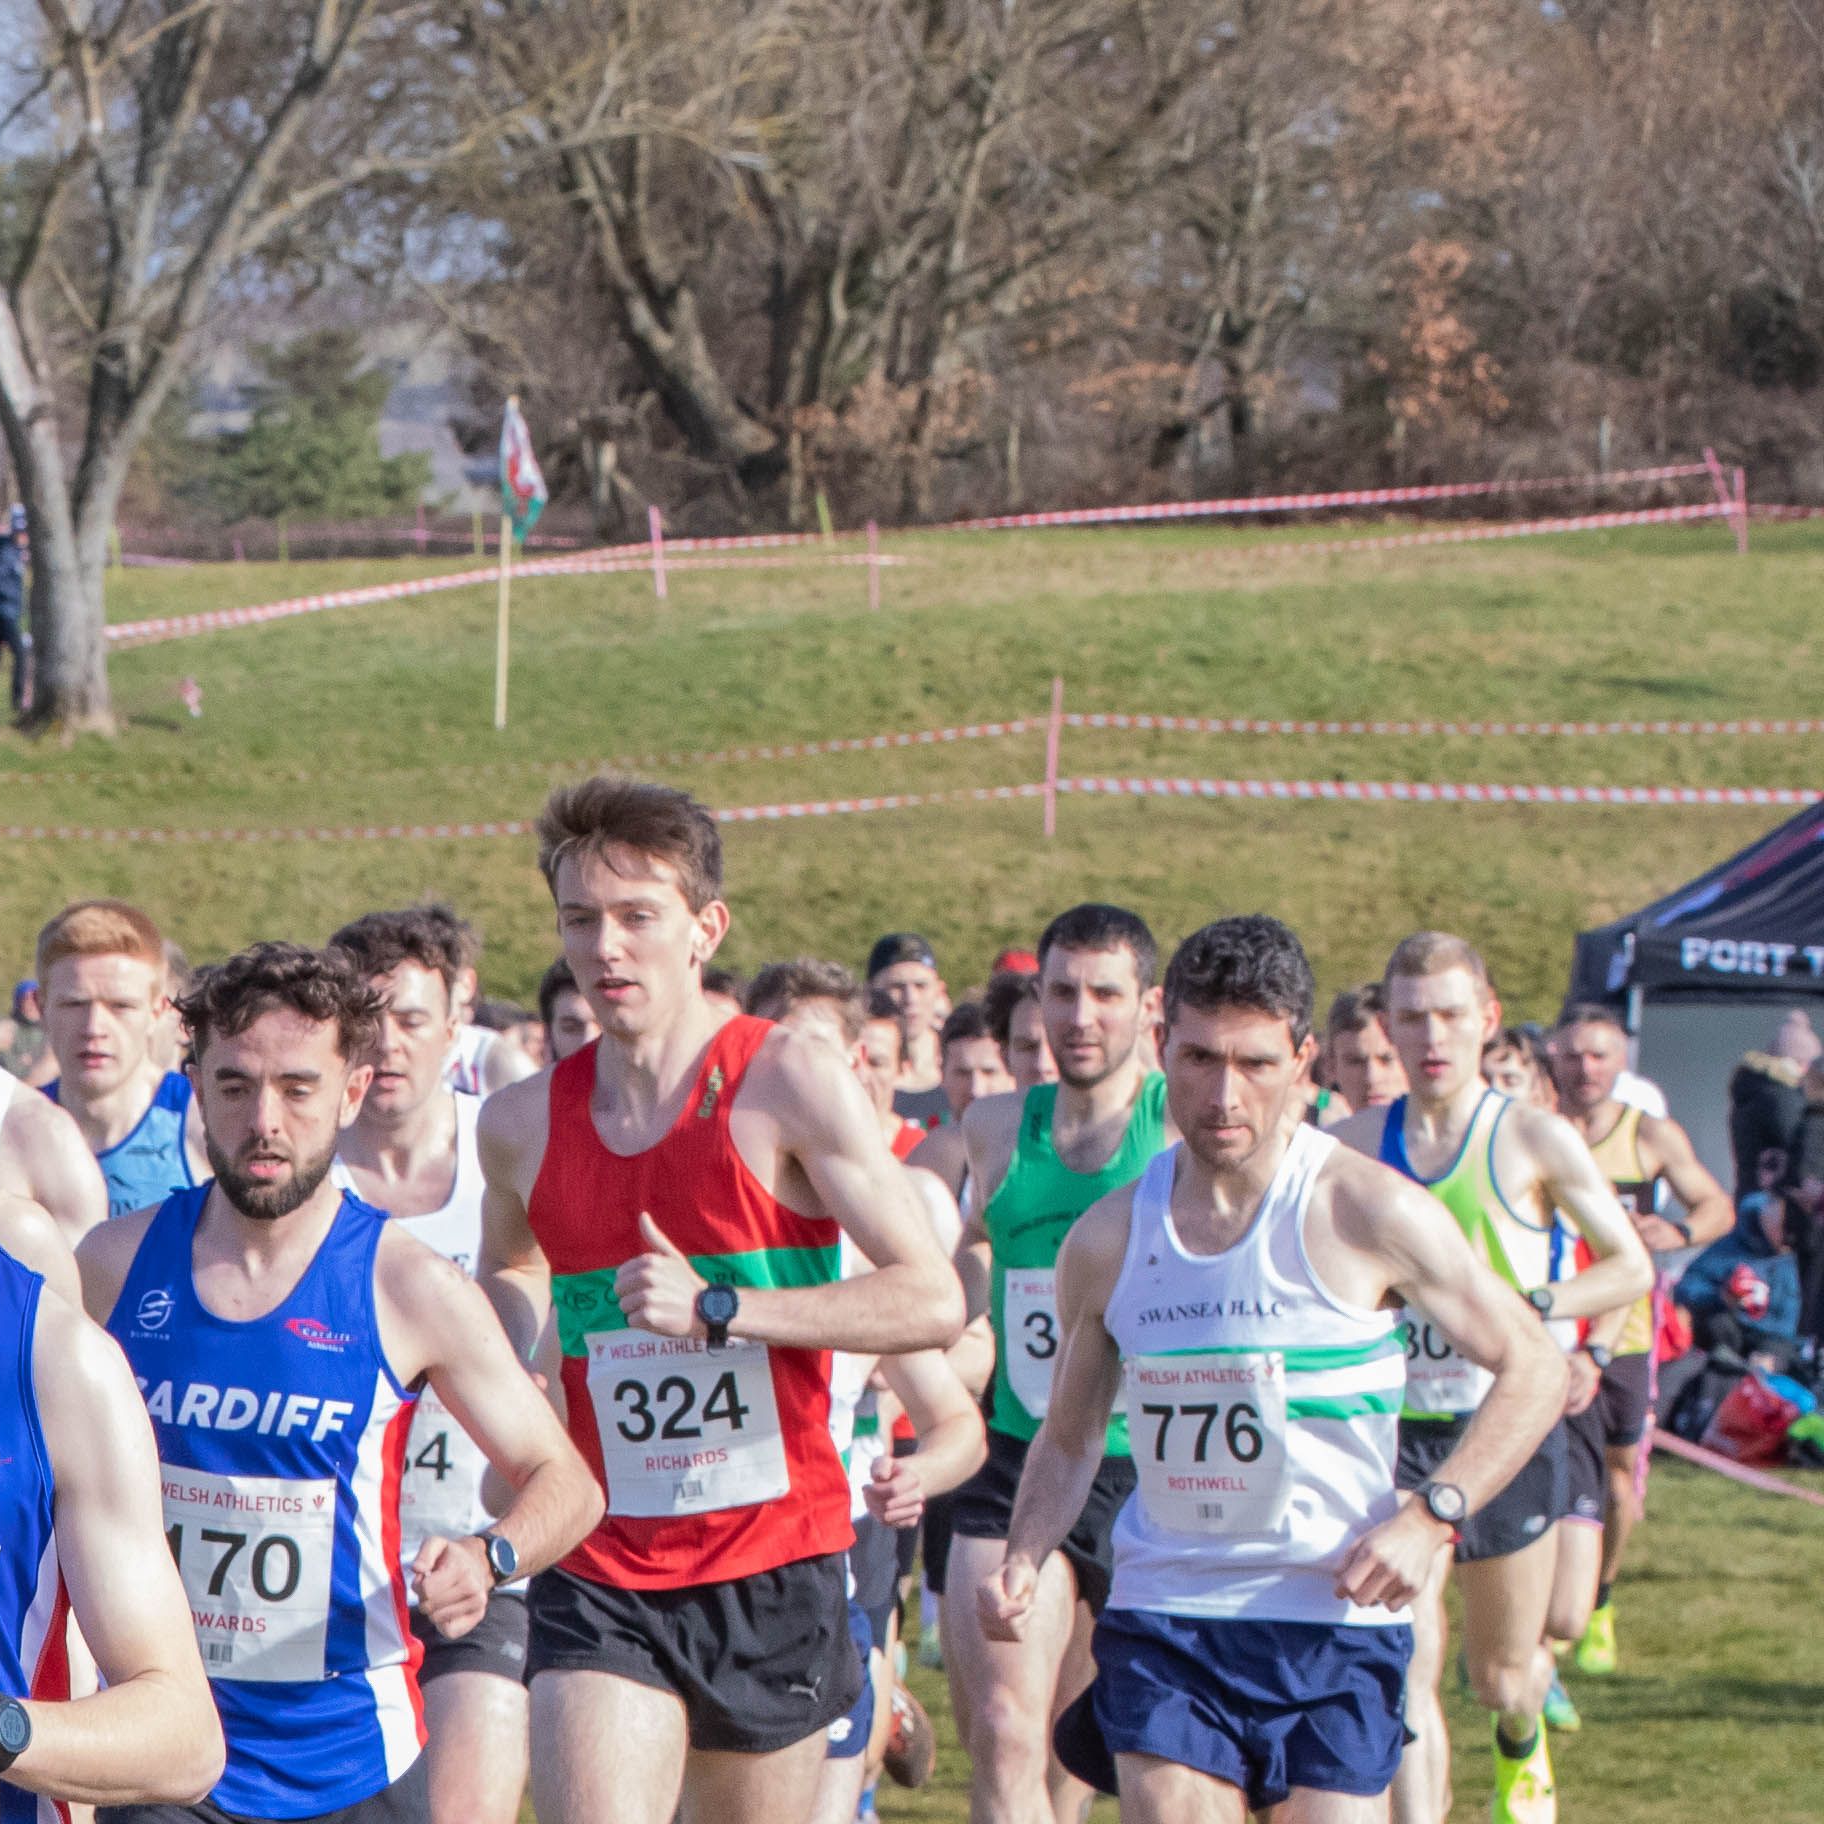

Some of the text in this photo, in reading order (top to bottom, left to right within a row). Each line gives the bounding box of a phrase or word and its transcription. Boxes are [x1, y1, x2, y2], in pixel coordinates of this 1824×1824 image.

[1680, 937, 1796, 977] PORT
[1138, 1301, 1223, 1326] SWANSEA
[1024, 1311, 1058, 1360] 3
[610, 1337, 736, 1360] WELSH ATHLES
[1139, 1367, 1256, 1385] WELSH ATHLETICS
[135, 1376, 355, 1443] ARDIFF
[613, 1370, 750, 1443] 324
[1141, 1403, 1264, 1463] 776
[403, 1431, 455, 1481] 4
[645, 1448, 729, 1471] RICHARDS
[1167, 1476, 1248, 1492] ROTHWELL
[213, 1492, 303, 1513] ATHLETICS
[191, 1611, 267, 1633] WARDS
